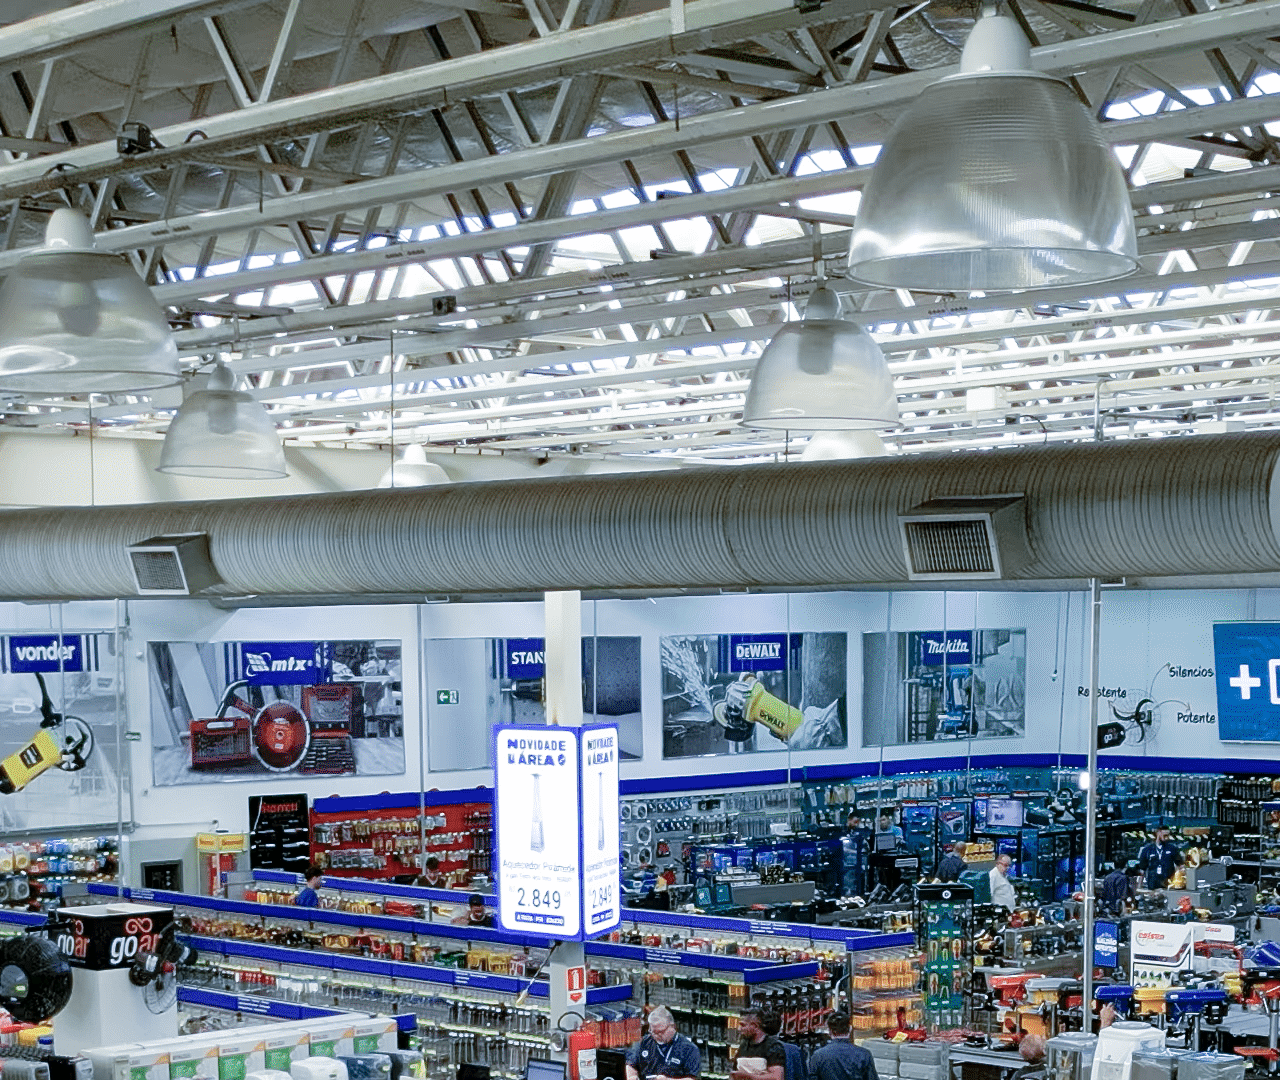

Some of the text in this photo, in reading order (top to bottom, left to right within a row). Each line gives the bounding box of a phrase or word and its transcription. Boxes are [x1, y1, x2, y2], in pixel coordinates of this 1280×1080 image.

[16, 641, 75, 661] vonder
[1169, 666, 1215, 679] Silencios
[1177, 712, 1216, 725] Potente
[507, 738, 566, 752] NOVIDADE
[518, 751, 555, 767] ÁREA
[517, 887, 562, 910] 2.849
[110, 933, 163, 965] goar
